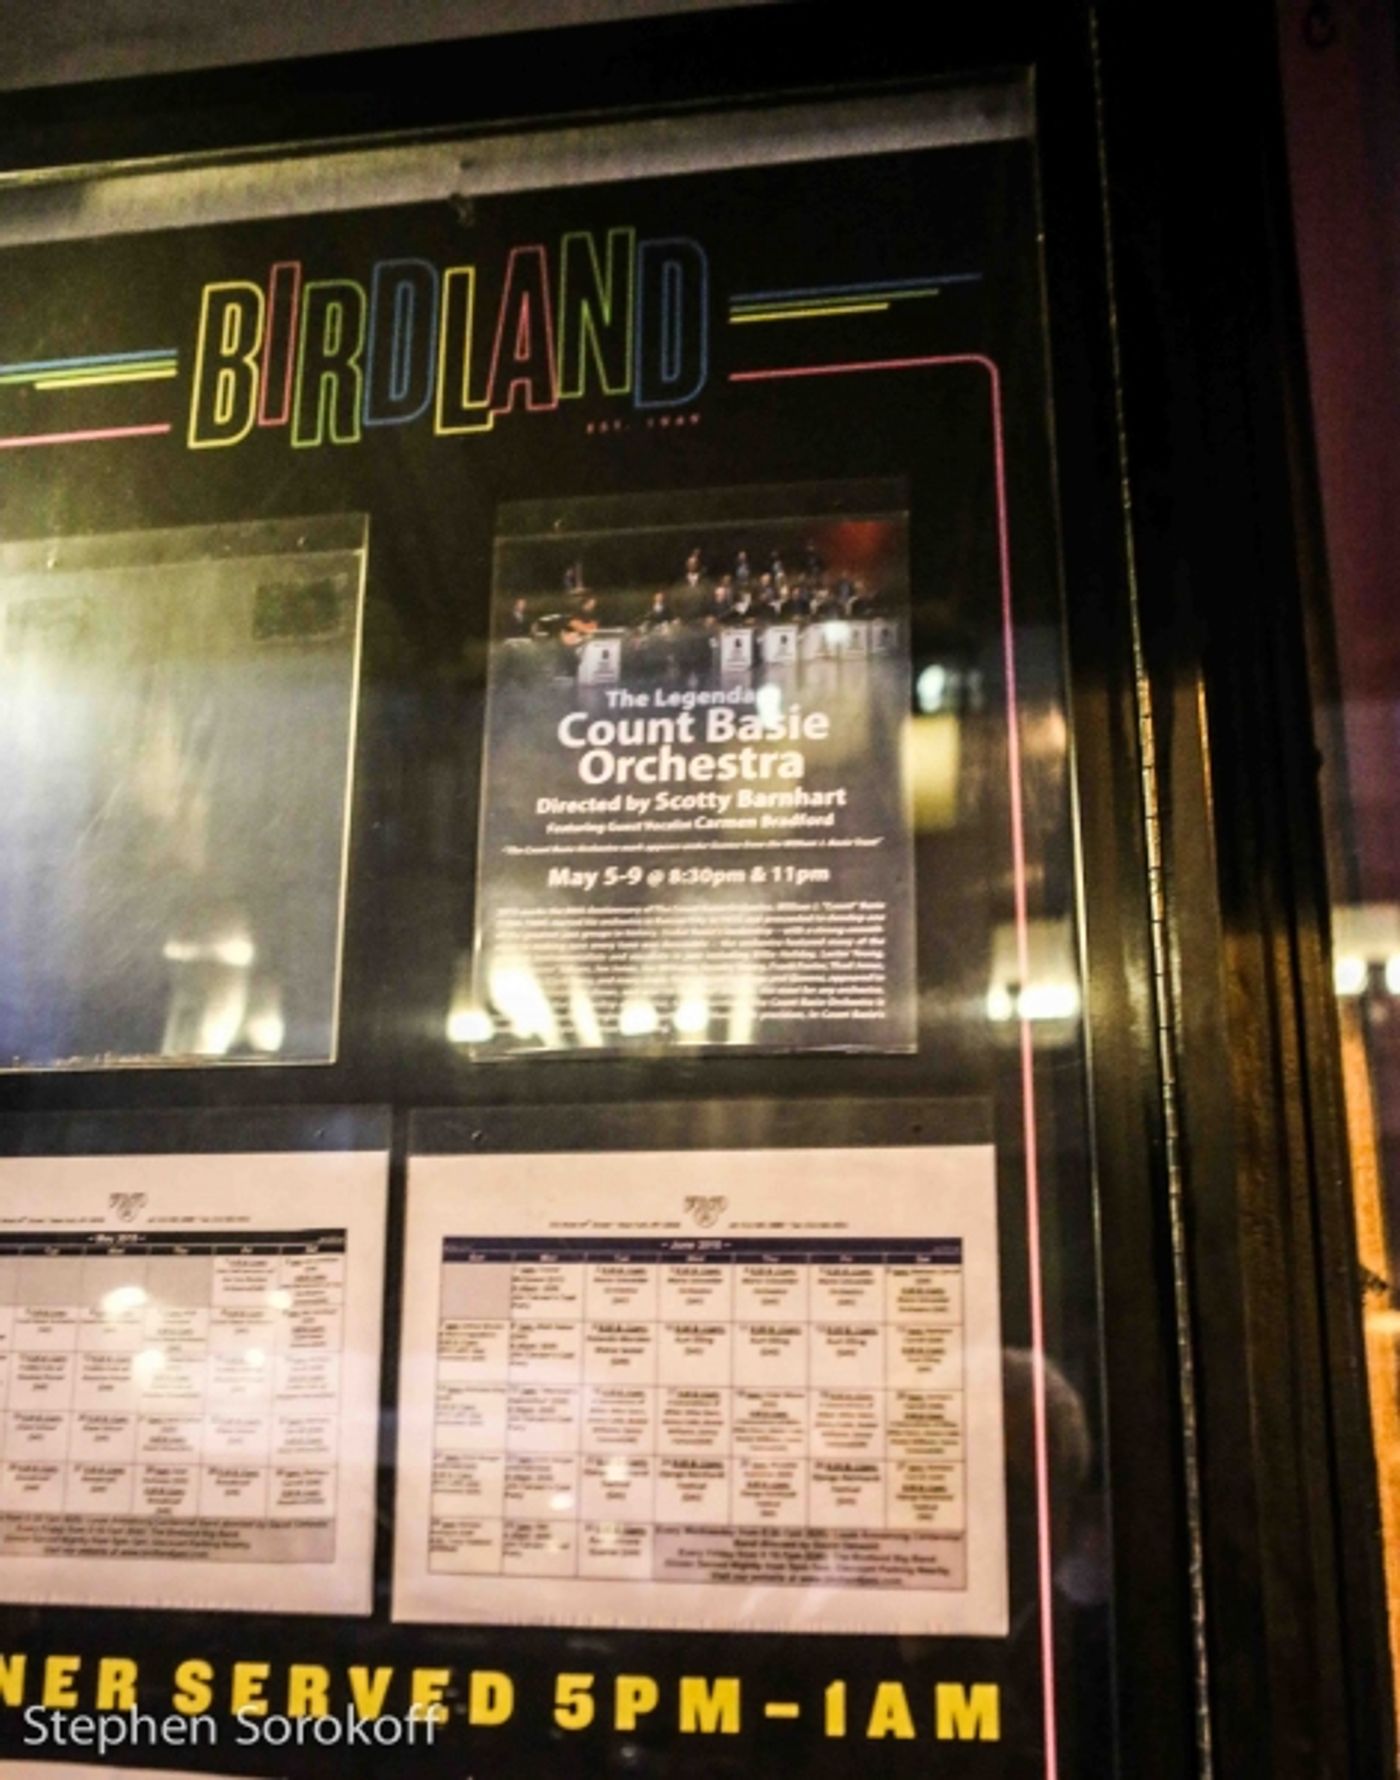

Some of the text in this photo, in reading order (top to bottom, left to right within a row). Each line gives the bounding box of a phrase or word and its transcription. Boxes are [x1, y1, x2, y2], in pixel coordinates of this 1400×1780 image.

[187, 226, 710, 450] BIRDLAND
[605, 684, 779, 711] The Legenda
[557, 703, 830, 749] Count Basie
[578, 743, 806, 785] Orchestra
[535, 785, 848, 815] Directed by Scotty Barnhart
[693, 815, 758, 830] Carmen
[760, 811, 836, 829] Bradford
[547, 866, 599, 892] May
[603, 865, 643, 887] 5-9
[667, 866, 747, 889] 8:30pm
[750, 865, 767, 883] &
[770, 865, 831, 886] 11pm
[0, 1654, 139, 1712] NER
[172, 1658, 516, 1728] SERVED
